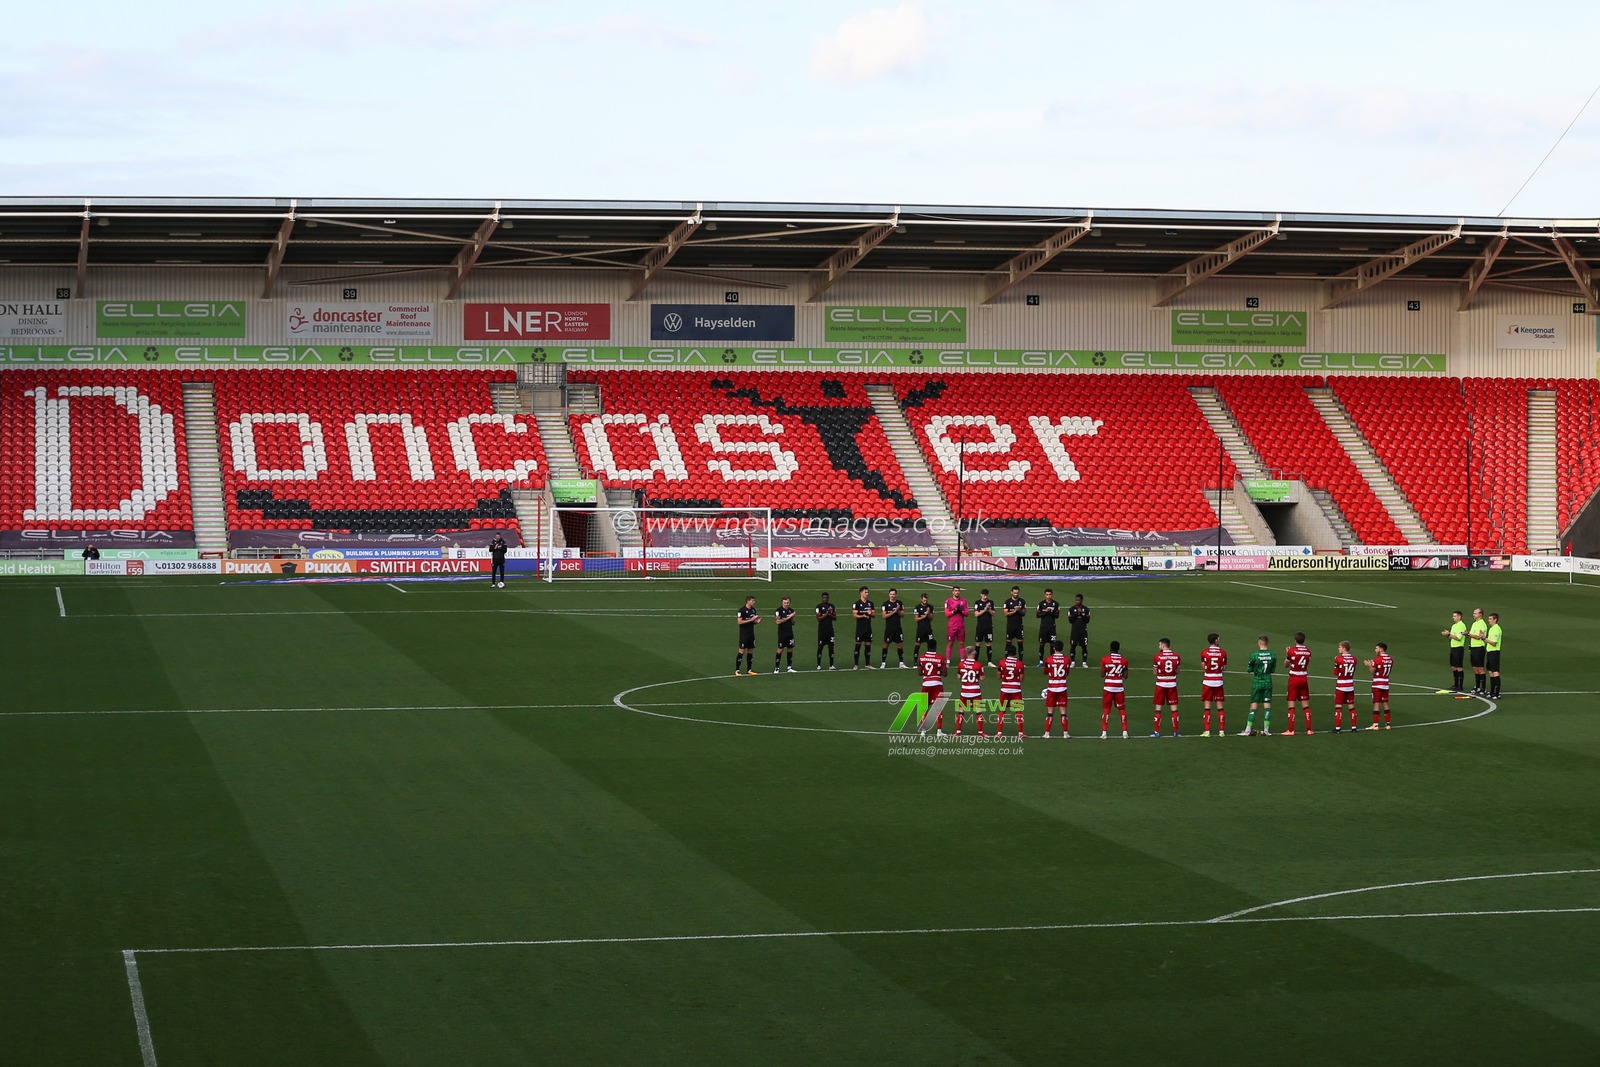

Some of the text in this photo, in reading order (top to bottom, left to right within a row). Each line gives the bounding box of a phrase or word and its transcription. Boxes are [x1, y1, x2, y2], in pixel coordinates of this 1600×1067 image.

[58, 289, 69, 298] 38
[727, 293, 738, 301] 40
[1028, 296, 1039, 304] 41
[1247, 299, 1258, 307] 42
[1408, 302, 1419, 310] 43
[23, 304, 62, 316] HALL
[103, 303, 240, 317] ELLGIA
[313, 308, 382, 322] doncaster
[830, 309, 961, 323] ELLGIA
[485, 306, 562, 337] LNER
[695, 317, 755, 330] Hayselden
[1177, 313, 1301, 327] ELLGIA
[313, 323, 382, 333] maintenance
[1521, 326, 1554, 335] Keepmoat
[0, 347, 1435, 369] LLGIA ELLGIA ELLGIA ELLGIA ELLGIA ELLGIA ELLGIA ELLGIA
[1363, 547, 1401, 555] doncaster
[162, 562, 217, 570] 01302 986888
[225, 561, 272, 573] PUKKA
[370, 561, 479, 573] SMITH CRAVEN
[559, 561, 580, 571] bet
[834, 561, 874, 570] Stoneacre
[893, 559, 933, 571] utilita
[1019, 558, 1079, 570] ADRIAN WELCH
[1080, 556, 1142, 566] GLASS & GLAZING
[1268, 556, 1388, 571] Anderson Hydraulics
[1524, 558, 1562, 568] Stoneacre
[18, 564, 55, 574] Health
[305, 562, 353, 573] PUKKA
[1164, 660, 1173, 674] 8
[1210, 657, 1219, 671] 5
[1298, 656, 1307, 668] 4
[925, 662, 934, 676] 9
[1005, 667, 1015, 680] 3
[1053, 664, 1066, 678] 16
[1106, 664, 1122, 677] 24
[1343, 663, 1355, 676] 14
[1383, 664, 1392, 676] 11
[960, 669, 976, 683] 20
